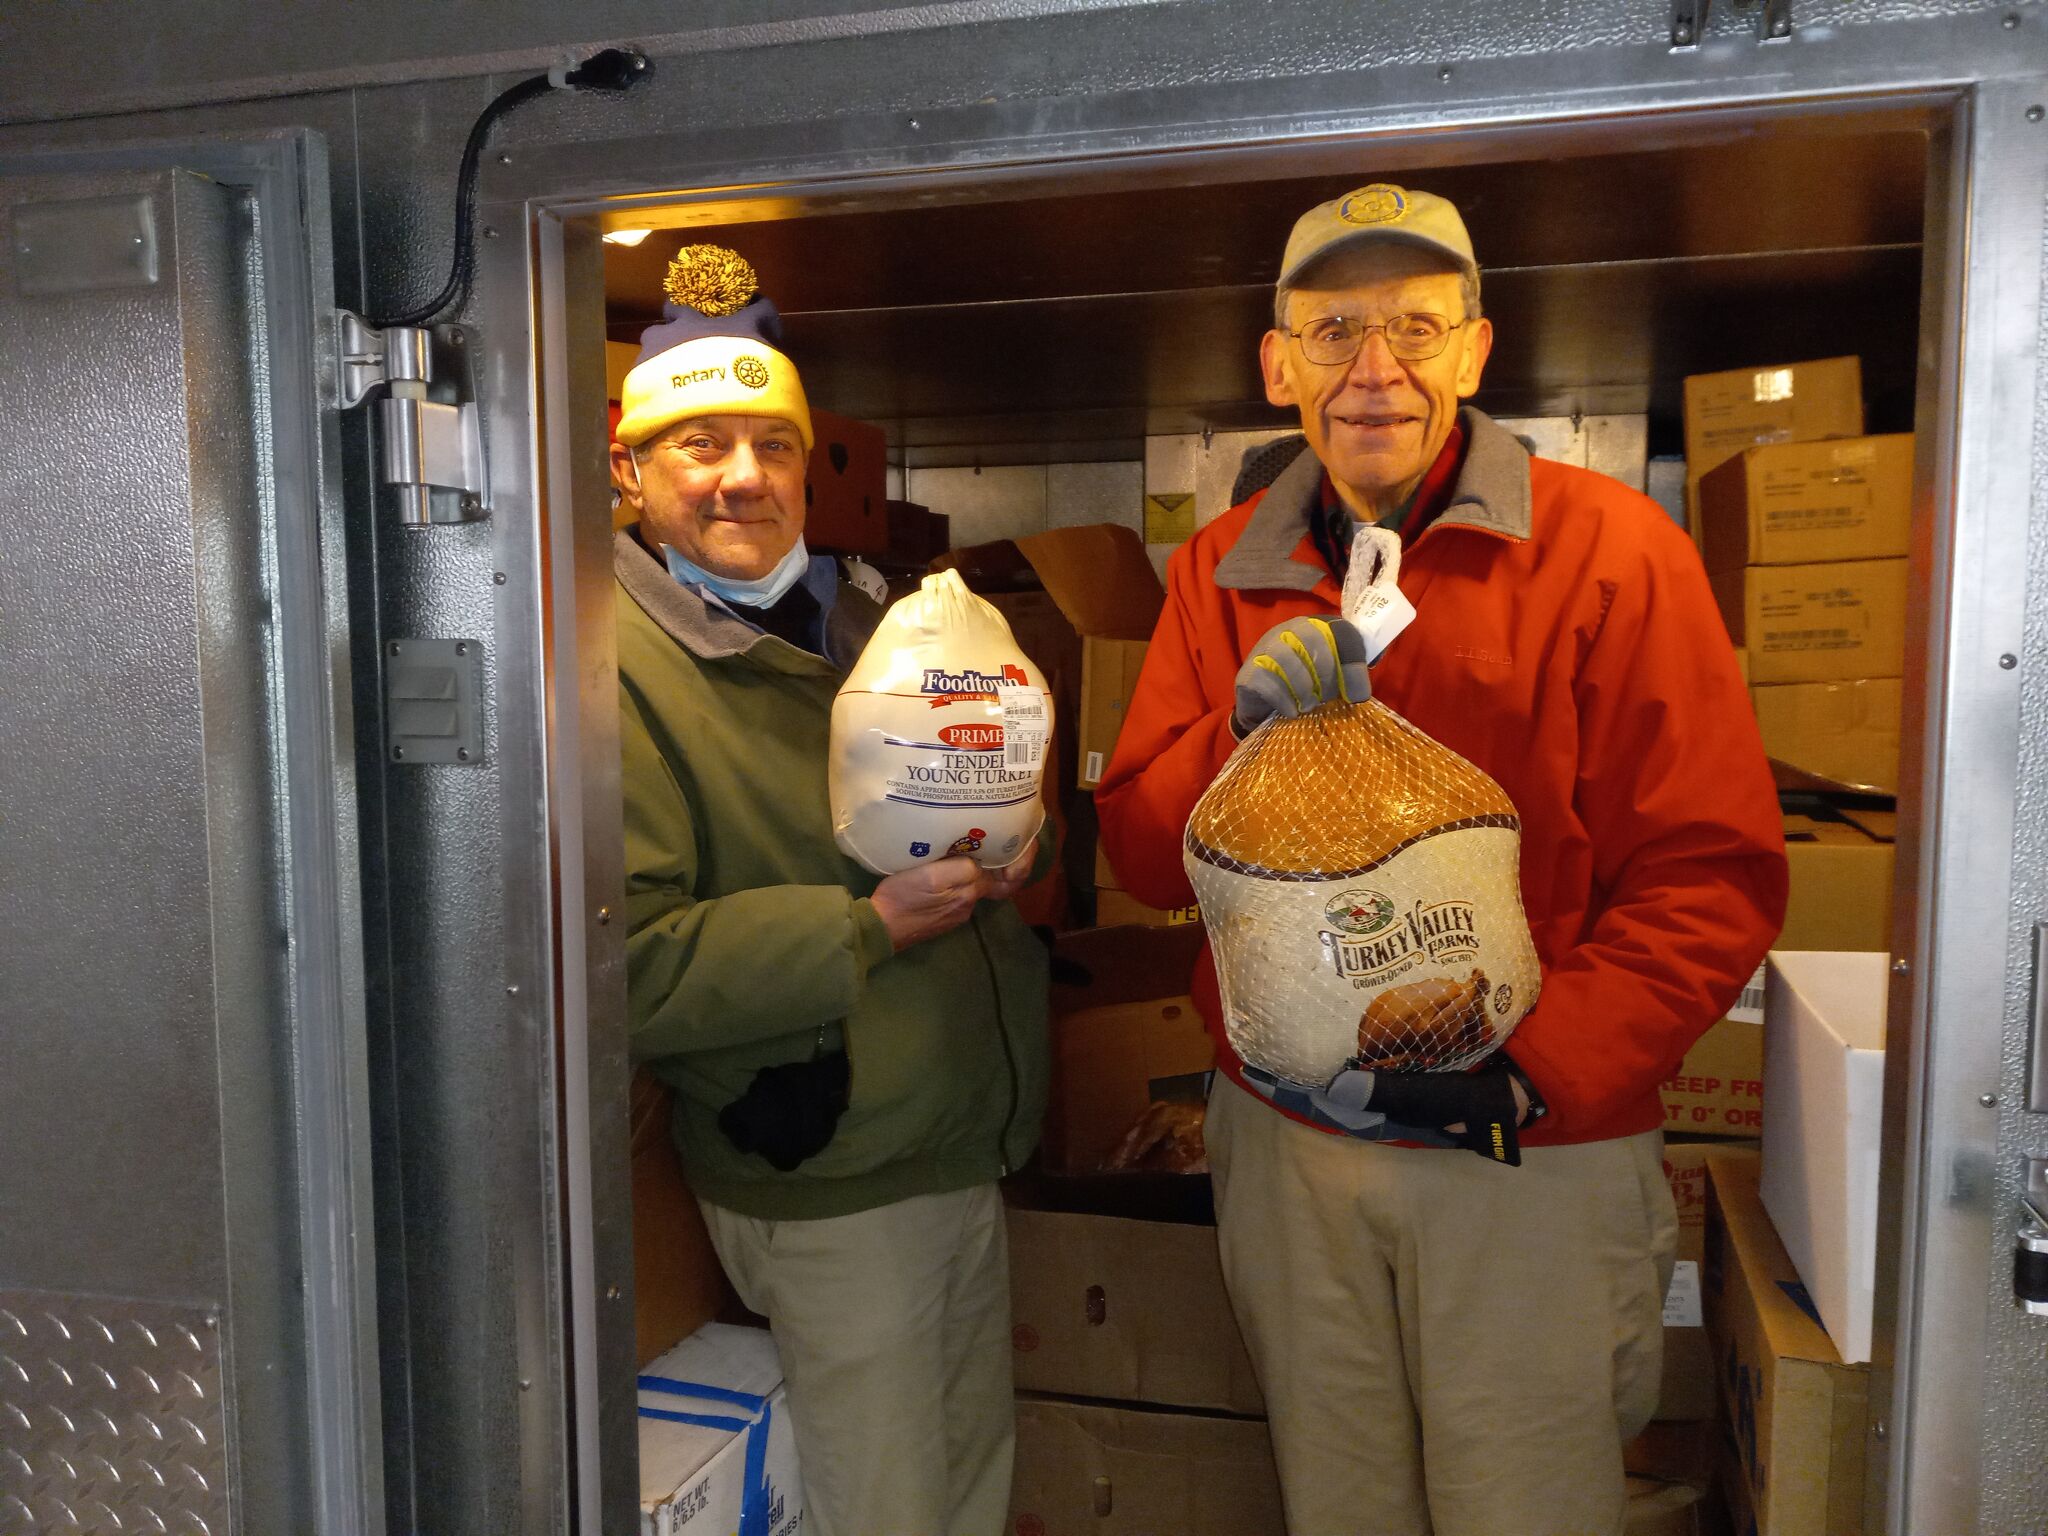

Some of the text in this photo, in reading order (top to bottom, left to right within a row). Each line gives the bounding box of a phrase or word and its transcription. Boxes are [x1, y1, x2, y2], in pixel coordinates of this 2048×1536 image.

[671, 367, 726, 389] Rotary
[943, 694, 974, 702] QUALITY
[949, 728, 1003, 743] PRIME
[906, 765, 970, 785] YOUNG
[886, 779, 919, 791] CONTAINS
[920, 786, 973, 795] APPROXIMATELY
[896, 787, 922, 798] SODIUM
[674, 1476, 711, 1518] NET WT.
